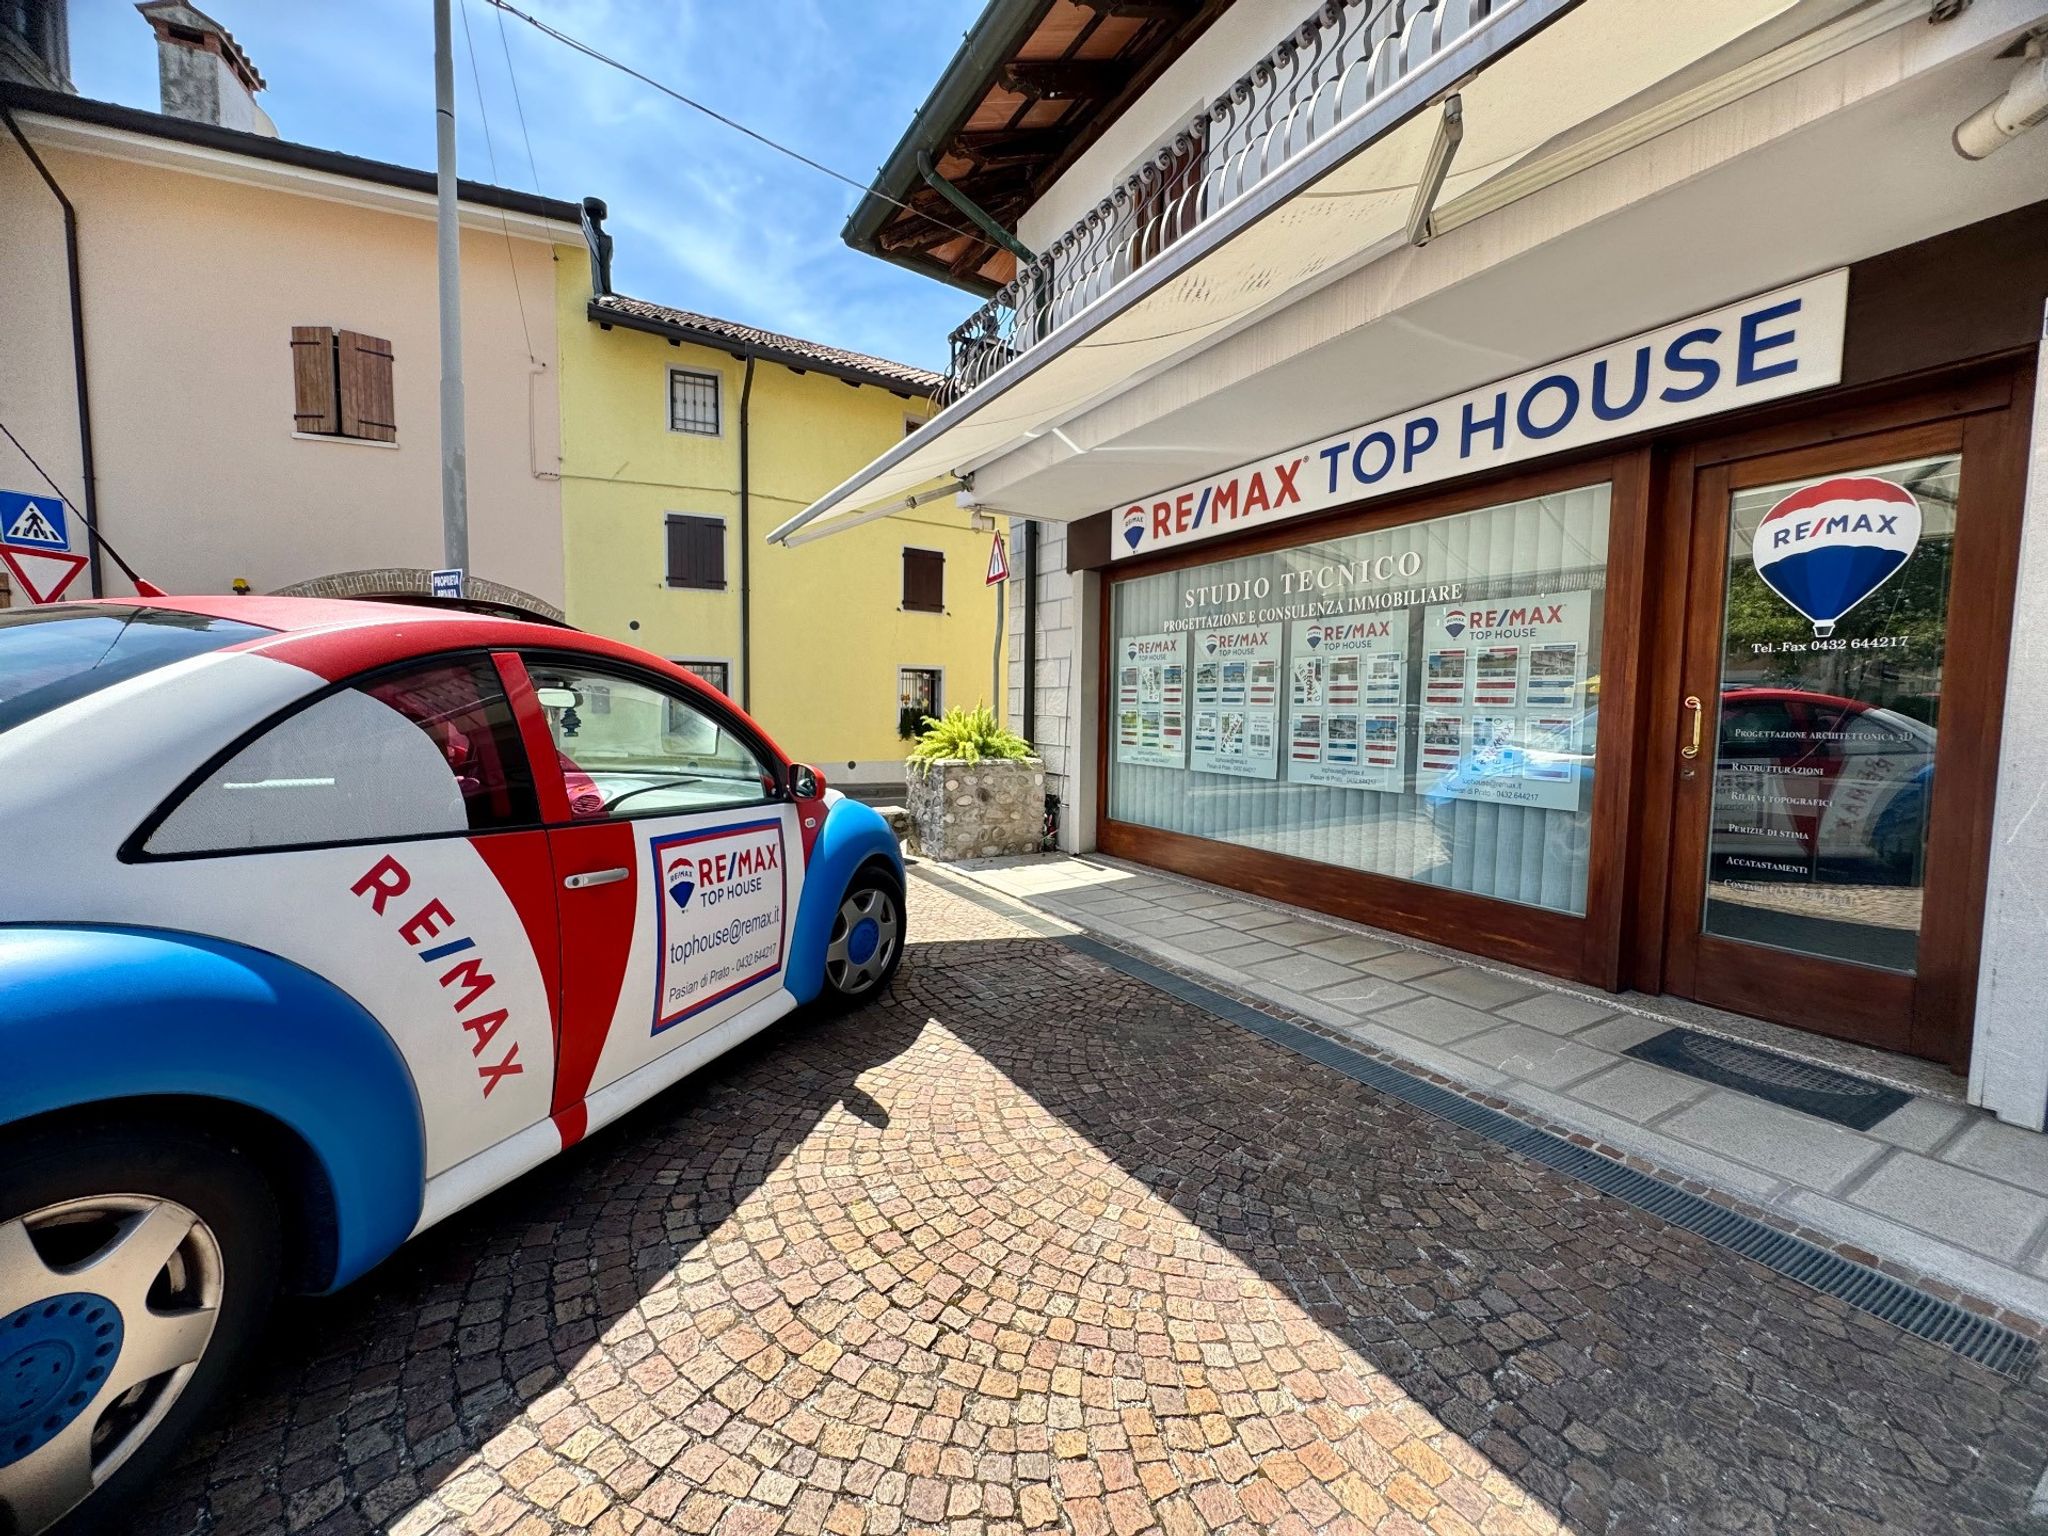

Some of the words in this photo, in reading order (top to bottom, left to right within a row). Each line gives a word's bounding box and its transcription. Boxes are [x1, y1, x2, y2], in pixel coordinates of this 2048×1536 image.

[1153, 459, 1302, 539] RE/MAX
[1320, 416, 1438, 494] TOP
[1460, 298, 1801, 459] HOUSE
[1773, 514, 1898, 549] RE/MAX
[1185, 576, 1270, 608] STUDIO
[1281, 551, 1422, 595] TECNICO
[1163, 611, 1246, 632] PROGETTAZIONE
[1249, 610, 1256, 622] E
[1259, 599, 1343, 621] CONSULENZA
[1348, 583, 1463, 613] IMMOBILIARE
[1470, 605, 1562, 628] RE/MAX
[1219, 632, 1268, 648] RE/MAX
[1324, 621, 1390, 641] RE/MAX
[1470, 630, 1492, 640] TOP
[1495, 628, 1536, 639] HOUSE
[1138, 640, 1177, 654] RE/MAX
[1233, 648, 1255, 656] HOUSE
[1324, 642, 1340, 651] TOP
[1342, 640, 1371, 649] HOUSE
[1751, 642, 1807, 654] Tel.-Fax
[1811, 639, 1847, 651] 0432
[1850, 636, 1909, 649] 644217
[1735, 729, 1806, 740] PROGETTAZIONE
[1732, 763, 1824, 776] RISTRUTTURAZIONI
[1728, 824, 1764, 835] PERIZIE
[1779, 831, 1809, 840] STIMA
[699, 844, 778, 888] RE/MAX
[1726, 856, 1808, 874] ACCATASTAMENTI
[701, 887, 724, 907] TOP
[727, 877, 762, 900] HOUSE
[670, 905, 780, 965] tophouse@remax.it
[350, 854, 524, 1100] RE/MAX
[669, 980, 699, 1003] Pasian
[700, 972, 708, 988] di
[709, 966, 730, 984] Prato
